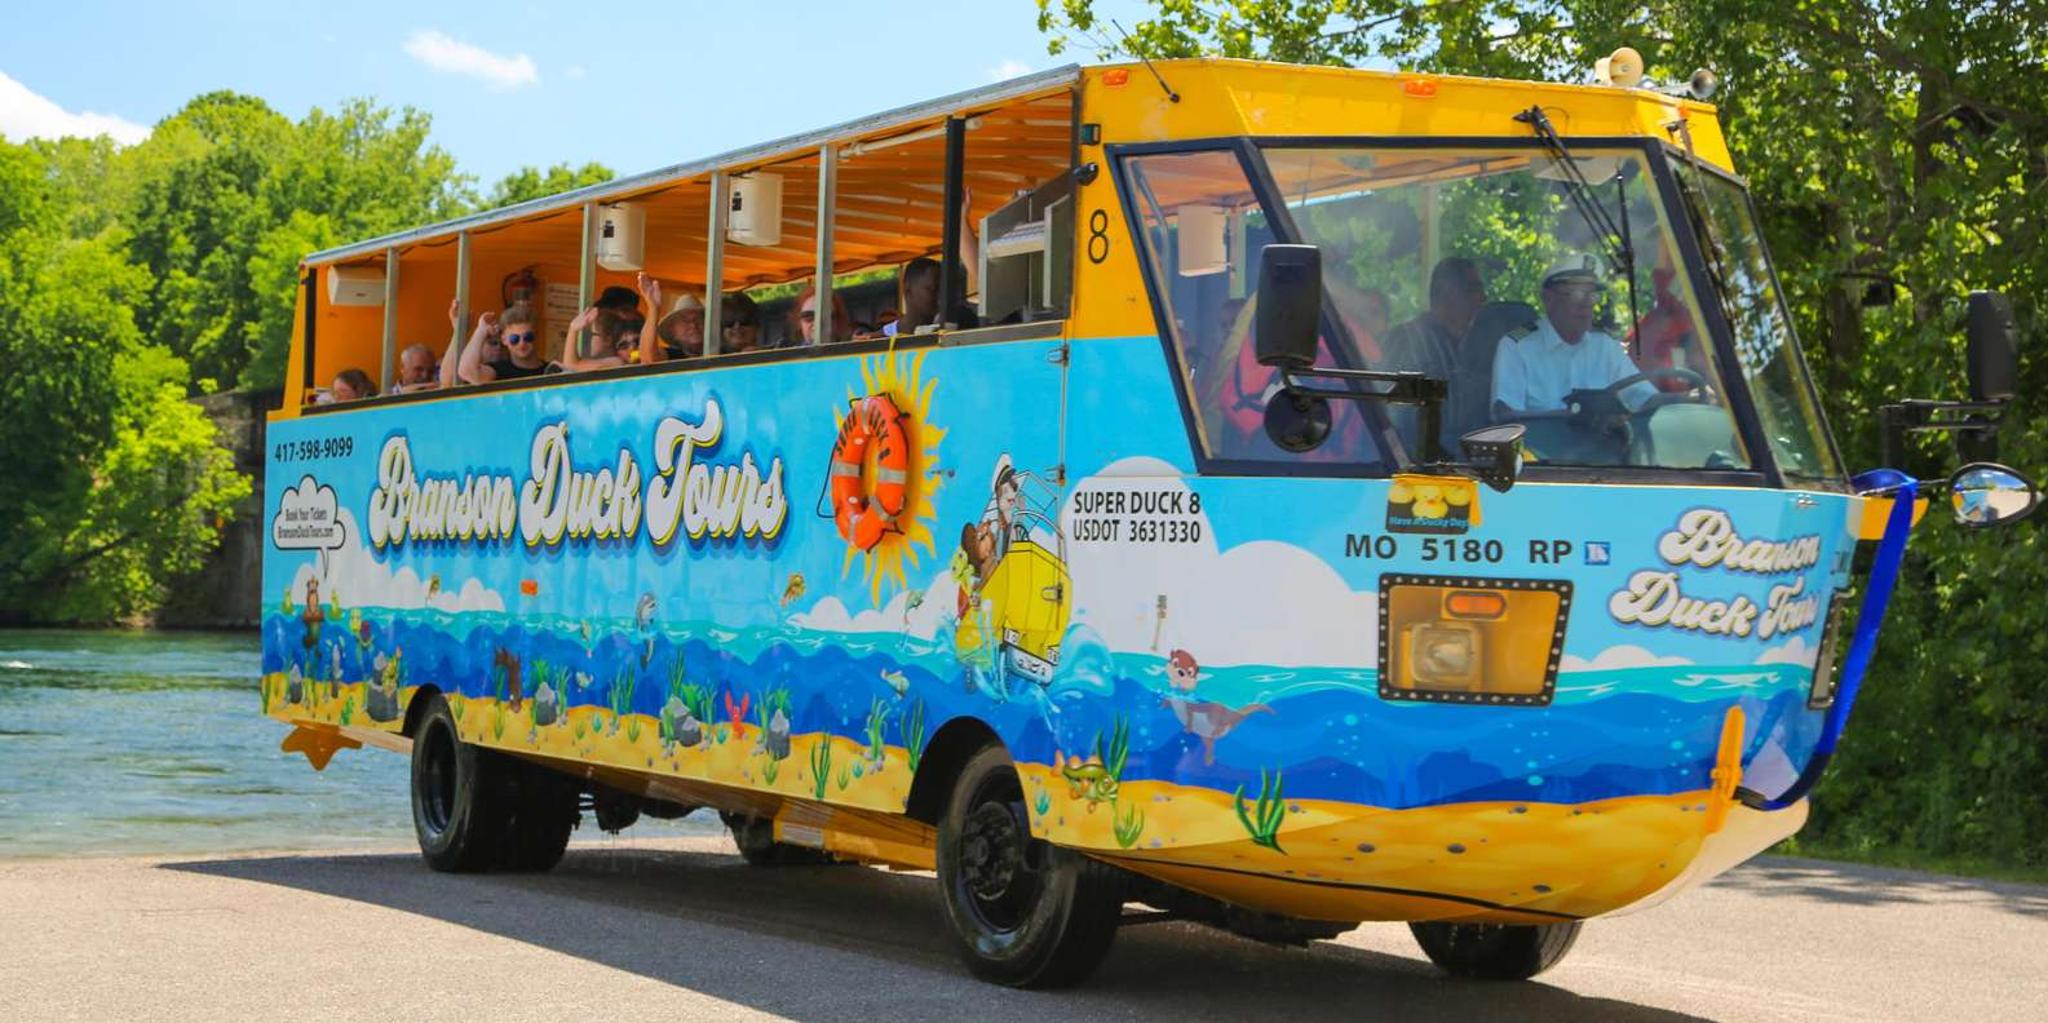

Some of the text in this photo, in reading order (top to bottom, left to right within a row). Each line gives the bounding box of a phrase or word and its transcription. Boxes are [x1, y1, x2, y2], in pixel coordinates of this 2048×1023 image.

[1088, 208, 1108, 265] 8
[275, 436, 353, 462] 417-598-9099
[369, 400, 787, 548] Branson Duck Tours
[1073, 491, 1201, 514] SUPER DUCK 8
[1073, 519, 1201, 543] USDOT 3631330
[1345, 533, 1573, 564] MO 5180 RP
[1659, 508, 1821, 574] Branson
[1610, 571, 1819, 640] Duck Tours
